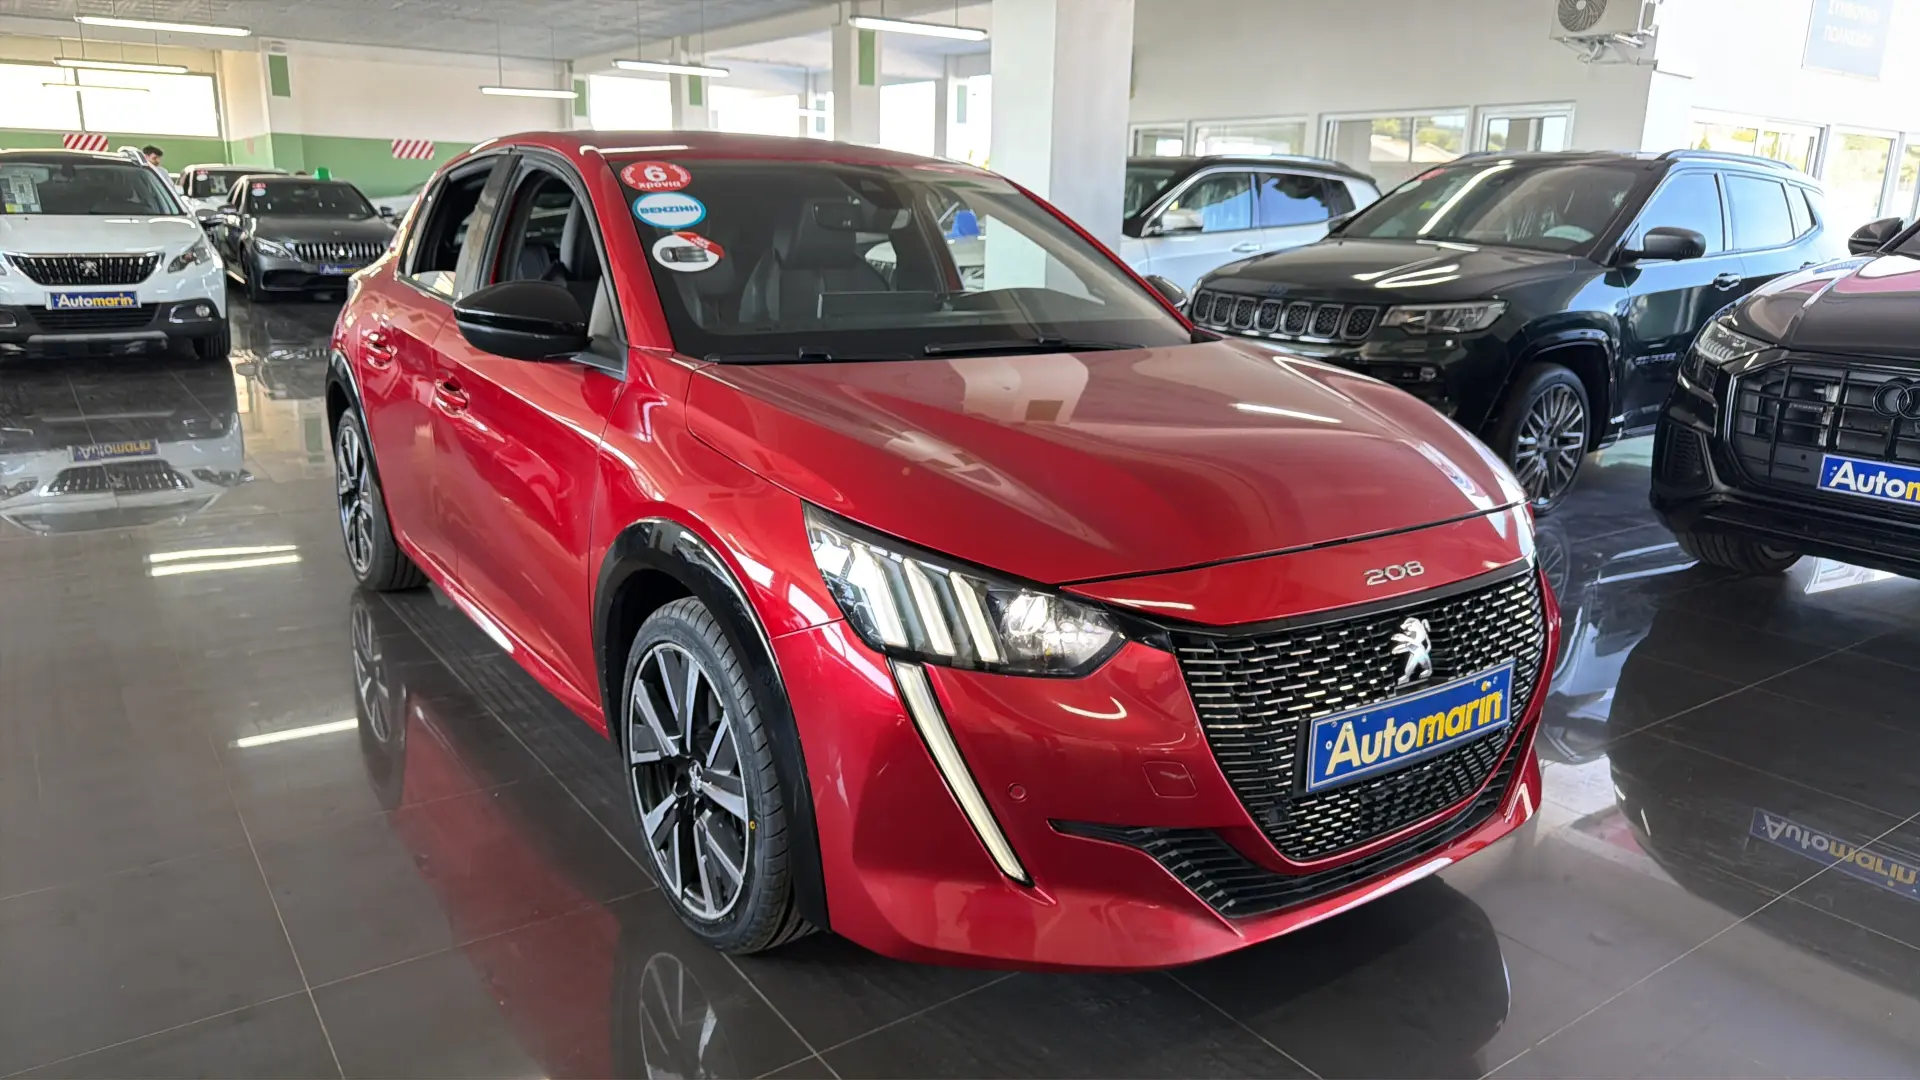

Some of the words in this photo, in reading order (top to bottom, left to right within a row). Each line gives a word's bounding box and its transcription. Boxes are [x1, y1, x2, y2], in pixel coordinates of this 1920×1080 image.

[644, 166, 667, 182] 6
[58, 293, 133, 308] Automarin
[1364, 561, 1425, 586] 208
[1325, 681, 1503, 775] Automarin
